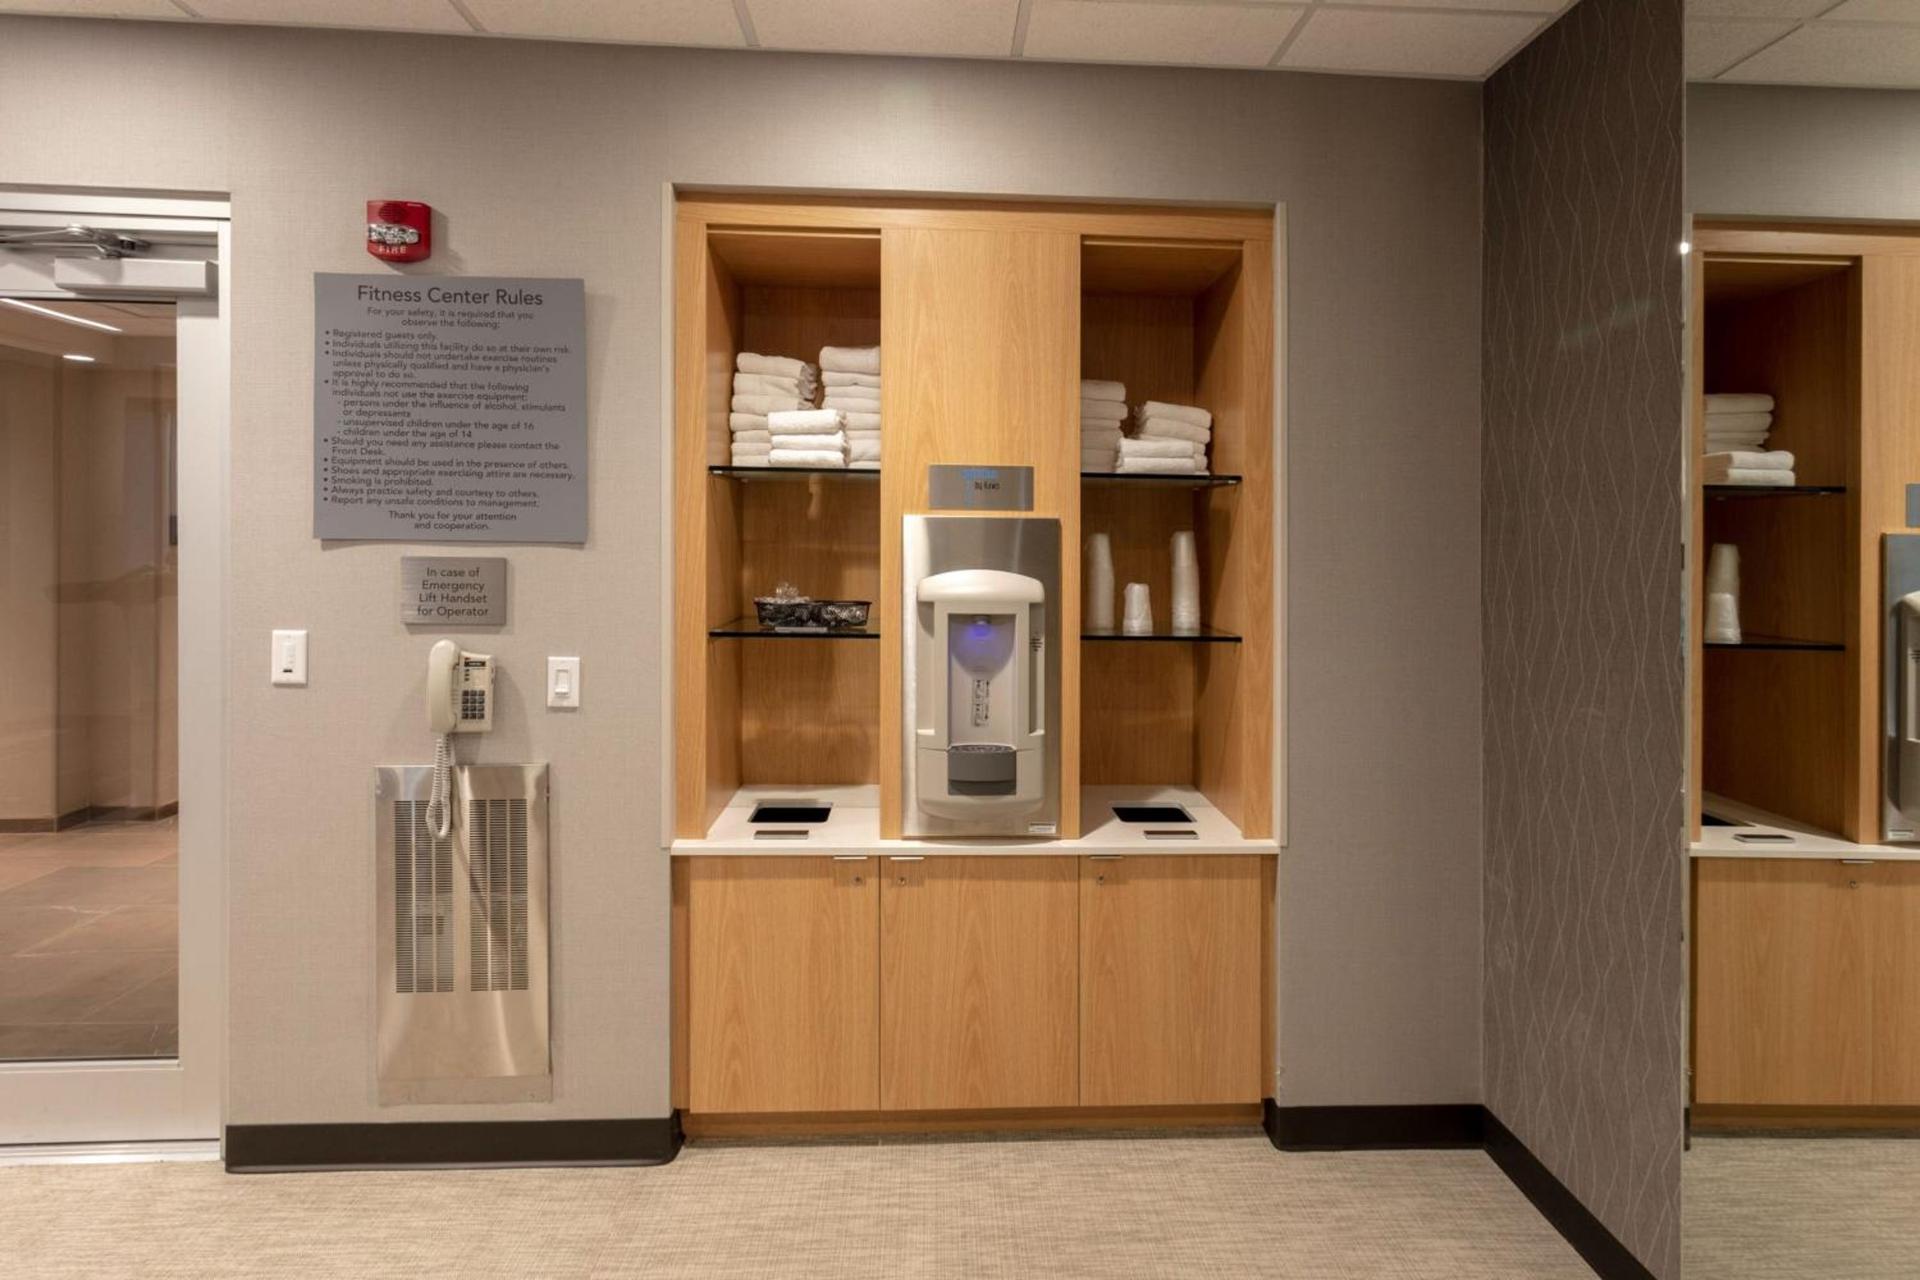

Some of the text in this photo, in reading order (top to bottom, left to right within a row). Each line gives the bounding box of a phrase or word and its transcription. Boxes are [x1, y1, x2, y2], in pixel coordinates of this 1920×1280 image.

[358, 285, 543, 305] Fitness Center Rules
[367, 307, 381, 315] For
[386, 309, 404, 318] your
[458, 309, 495, 320] required
[498, 310, 514, 318] that
[518, 312, 533, 321] you
[402, 318, 437, 327] observe
[440, 318, 454, 327] the
[333, 329, 382, 340] Registered
[385, 330, 414, 341] guests
[333, 340, 380, 349] Individuals
[384, 341, 418, 352] utilizing
[422, 342, 437, 351] this
[440, 342, 468, 353] facility
[511, 344, 529, 353] their
[333, 349, 557, 362] Individuals should not undertake exercise routines
[333, 359, 360, 368] unless
[365, 360, 406, 371] physically
[411, 361, 448, 372] qualified
[452, 362, 468, 370] and
[471, 362, 491, 371] have
[333, 369, 373, 379] approval
[352, 378, 378, 389] highly
[382, 379, 447, 389] recommended
[450, 381, 467, 389] that
[471, 381, 485, 390] the
[488, 382, 529, 393] following
[332, 388, 380, 397] individuals
[384, 389, 398, 398] not
[420, 390, 434, 399] the
[437, 390, 473, 399] exercise
[344, 400, 379, 409] persons
[383, 399, 408, 408] under
[412, 400, 426, 408] the
[429, 400, 469, 409] influence
[522, 402, 565, 412] stimulants
[356, 408, 410, 419] depressants
[343, 417, 404, 429] unsupervised
[407, 419, 443, 428] children
[445, 420, 471, 428] under
[474, 420, 489, 429] the
[492, 423, 508, 431] age
[344, 427, 379, 436] children
[384, 428, 408, 437] under
[412, 429, 426, 437] the
[430, 431, 446, 440] age
[331, 437, 559, 451] Should you need any assistance please contact the
[332, 446, 357, 455] Front
[331, 456, 381, 467] Equipment
[385, 457, 415, 466] should
[432, 458, 453, 467] used
[467, 459, 481, 468] the
[484, 461, 525, 471] presence
[331, 466, 359, 475] Shoes
[363, 467, 379, 475] and
[383, 467, 435, 478] appropriate
[438, 468, 483, 480] exercising
[486, 470, 510, 478] attire
[331, 476, 372, 487] Smoking
[331, 485, 363, 496] Always
[367, 486, 402, 497] practice
[407, 487, 432, 497] safety
[436, 487, 452, 496] and
[455, 488, 493, 499] courtesy
[331, 495, 363, 506] Report
[366, 497, 381, 506] any
[385, 496, 414, 505] unsafe
[417, 497, 463, 506] conditions
[389, 509, 516, 522] Thank you for your attention
[414, 520, 431, 529] and
[426, 567, 480, 577] In case of
[422, 580, 485, 593] Emergency
[419, 592, 488, 603] Lift Handset
[417, 606, 488, 619] for Operator
